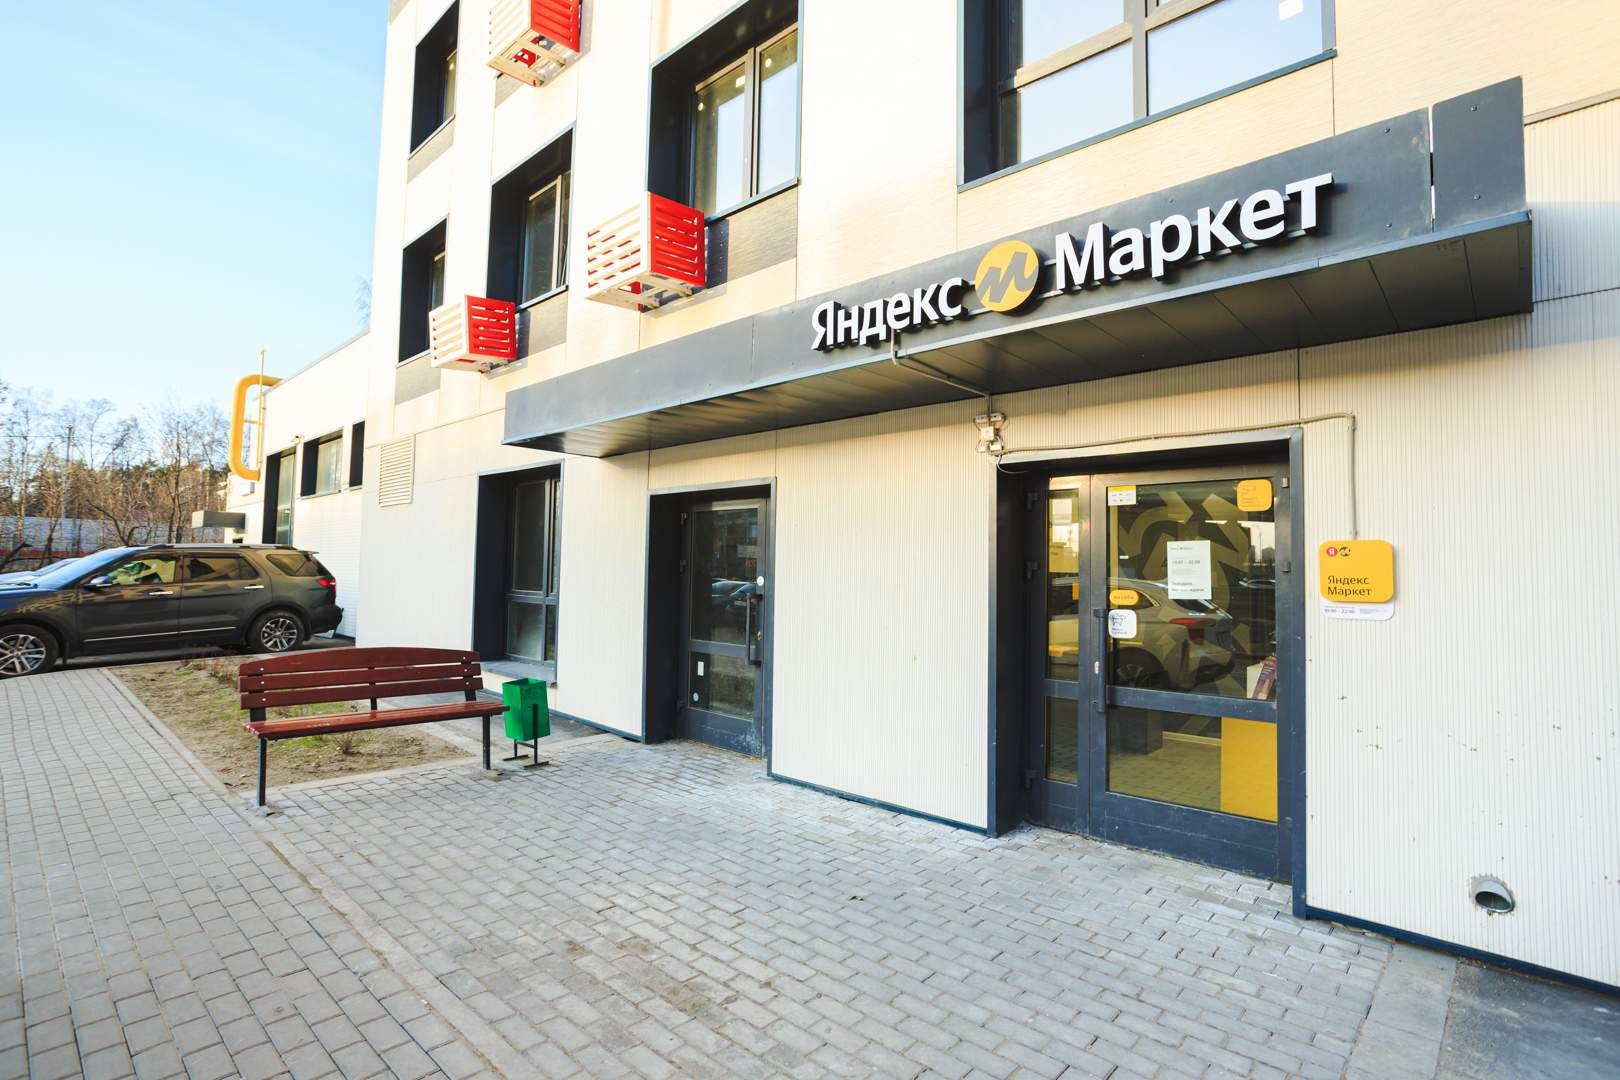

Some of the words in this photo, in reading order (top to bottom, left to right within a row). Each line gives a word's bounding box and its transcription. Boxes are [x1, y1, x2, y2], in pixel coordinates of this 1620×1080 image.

[811, 276, 962, 350] Яндекс
[1055, 173, 1333, 280] Маркет
[1327, 575, 1369, 585] Яндекс
[1327, 586, 1371, 596] Маркет
